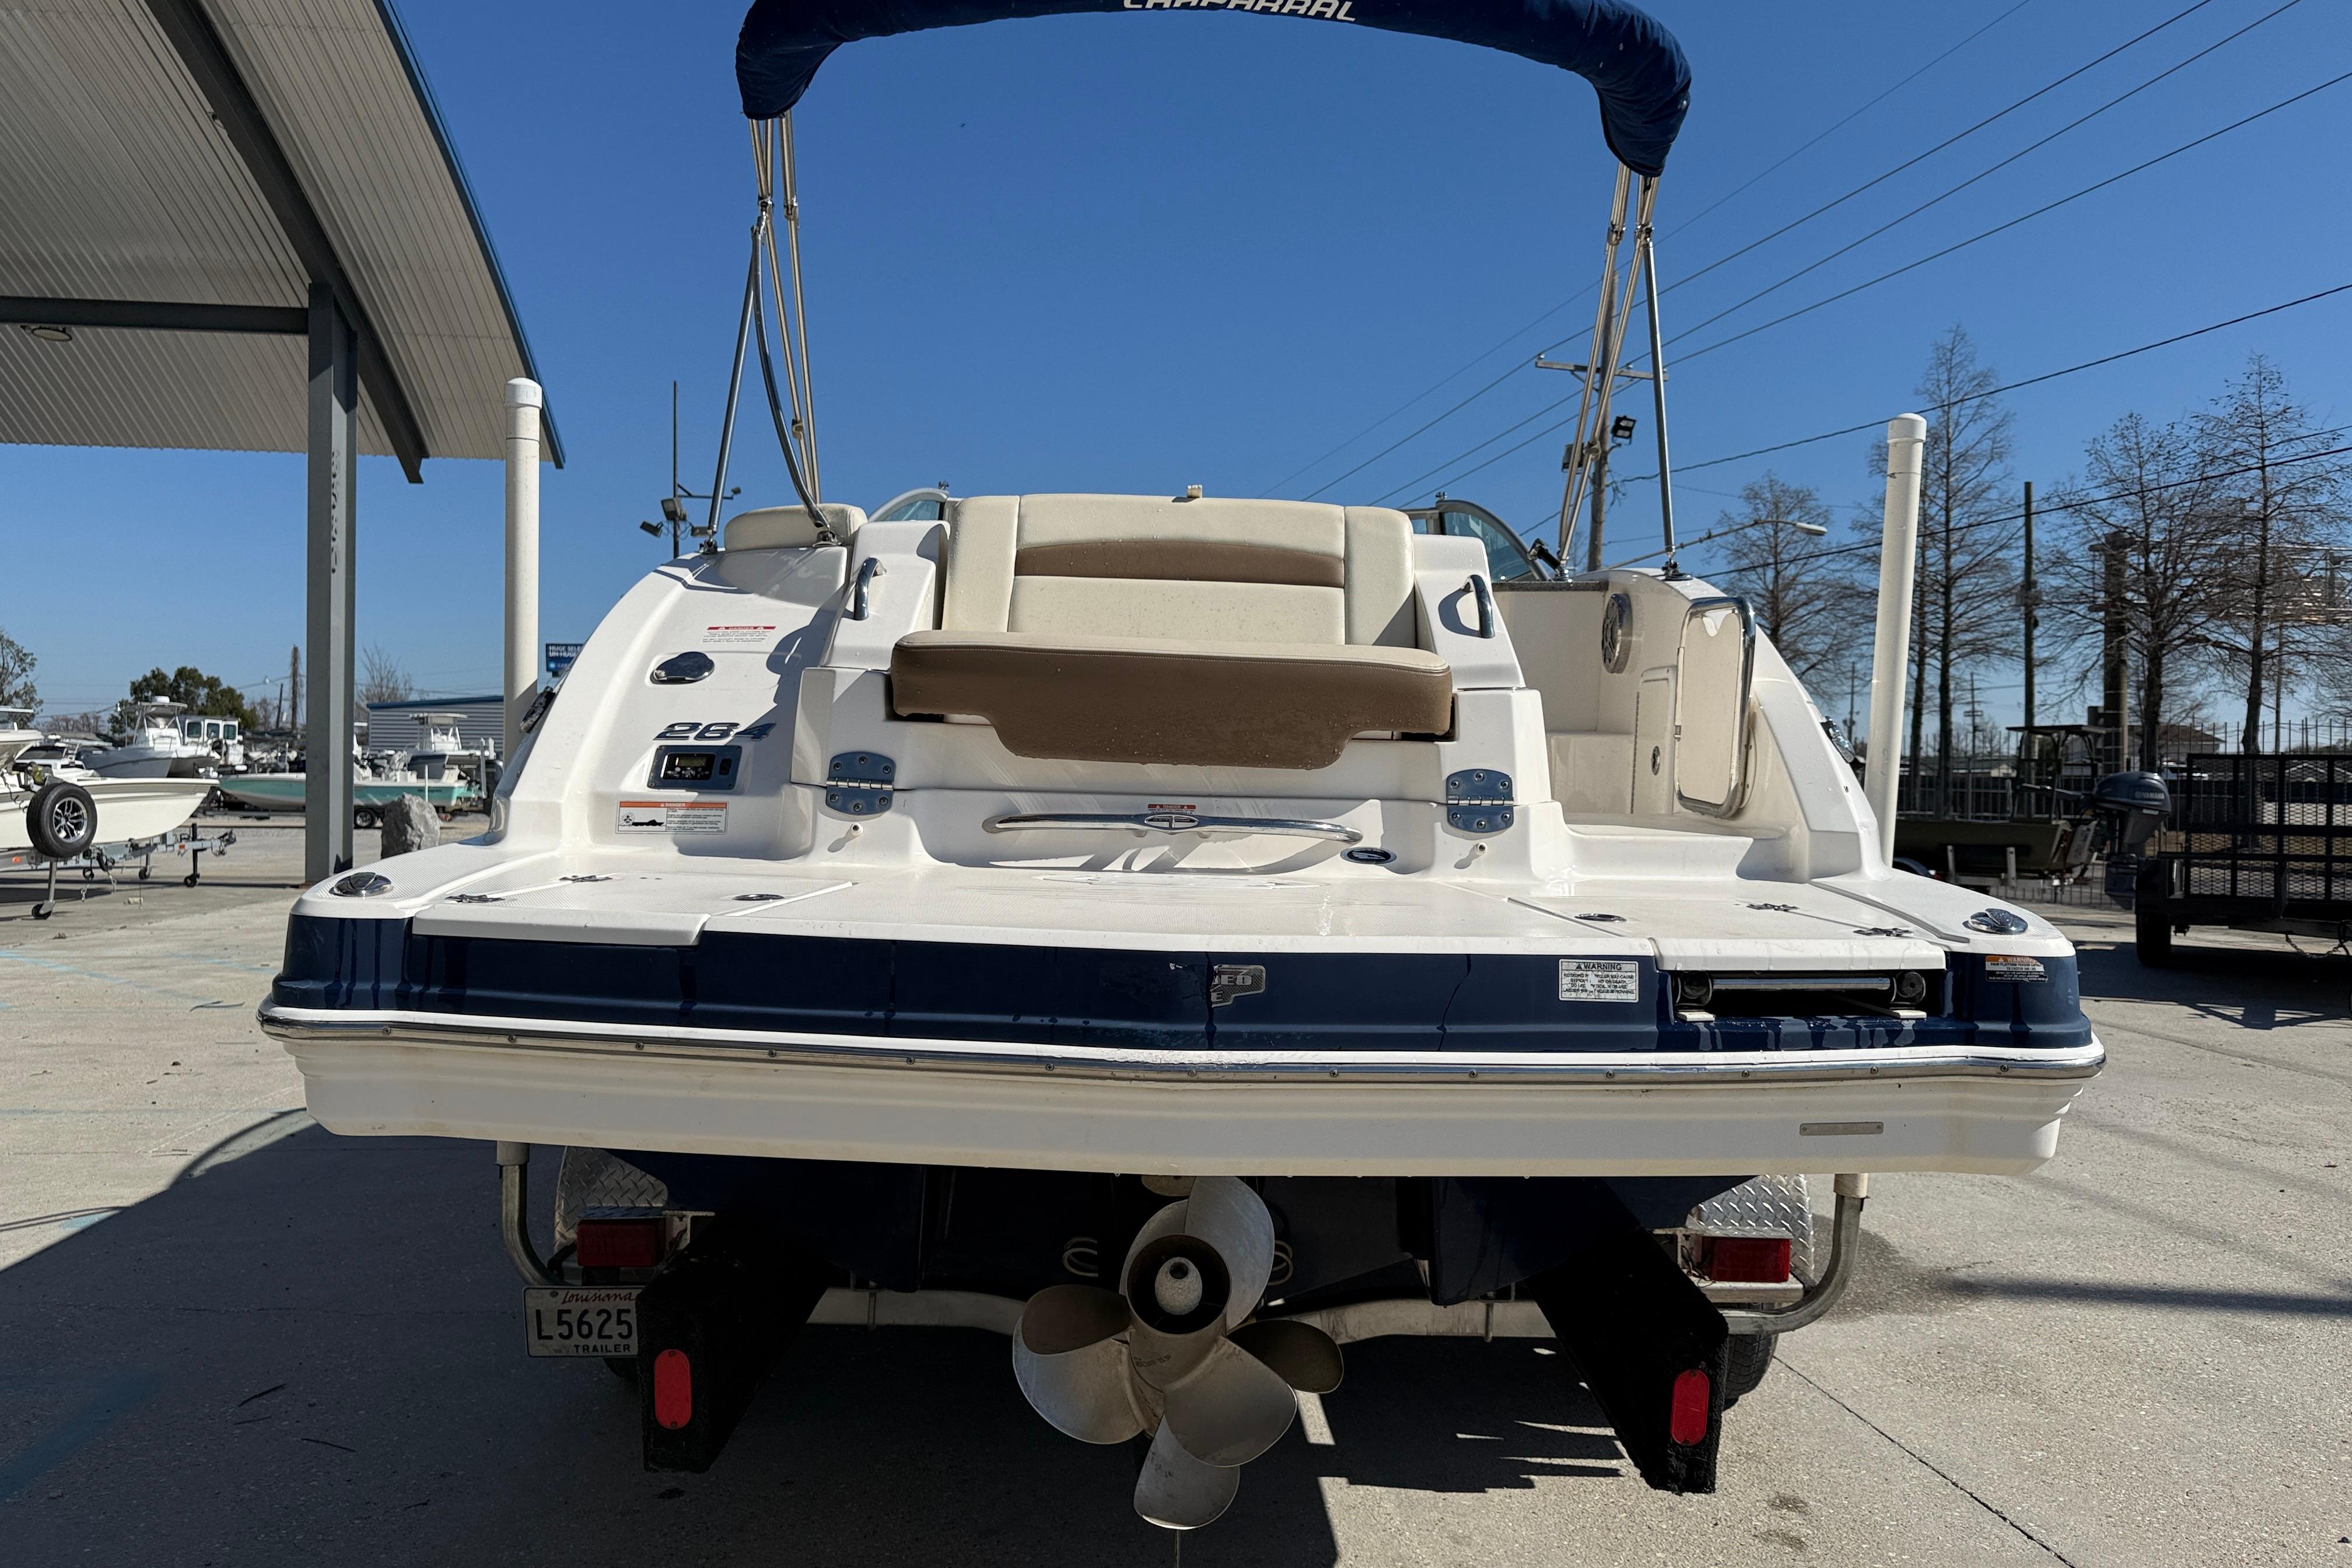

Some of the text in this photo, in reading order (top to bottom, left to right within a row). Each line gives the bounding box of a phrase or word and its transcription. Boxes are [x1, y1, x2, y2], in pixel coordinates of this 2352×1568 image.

[652, 722, 777, 741] 264
[561, 1290, 635, 1305] Louisiana
[573, 1345, 631, 1353] TRAILER
